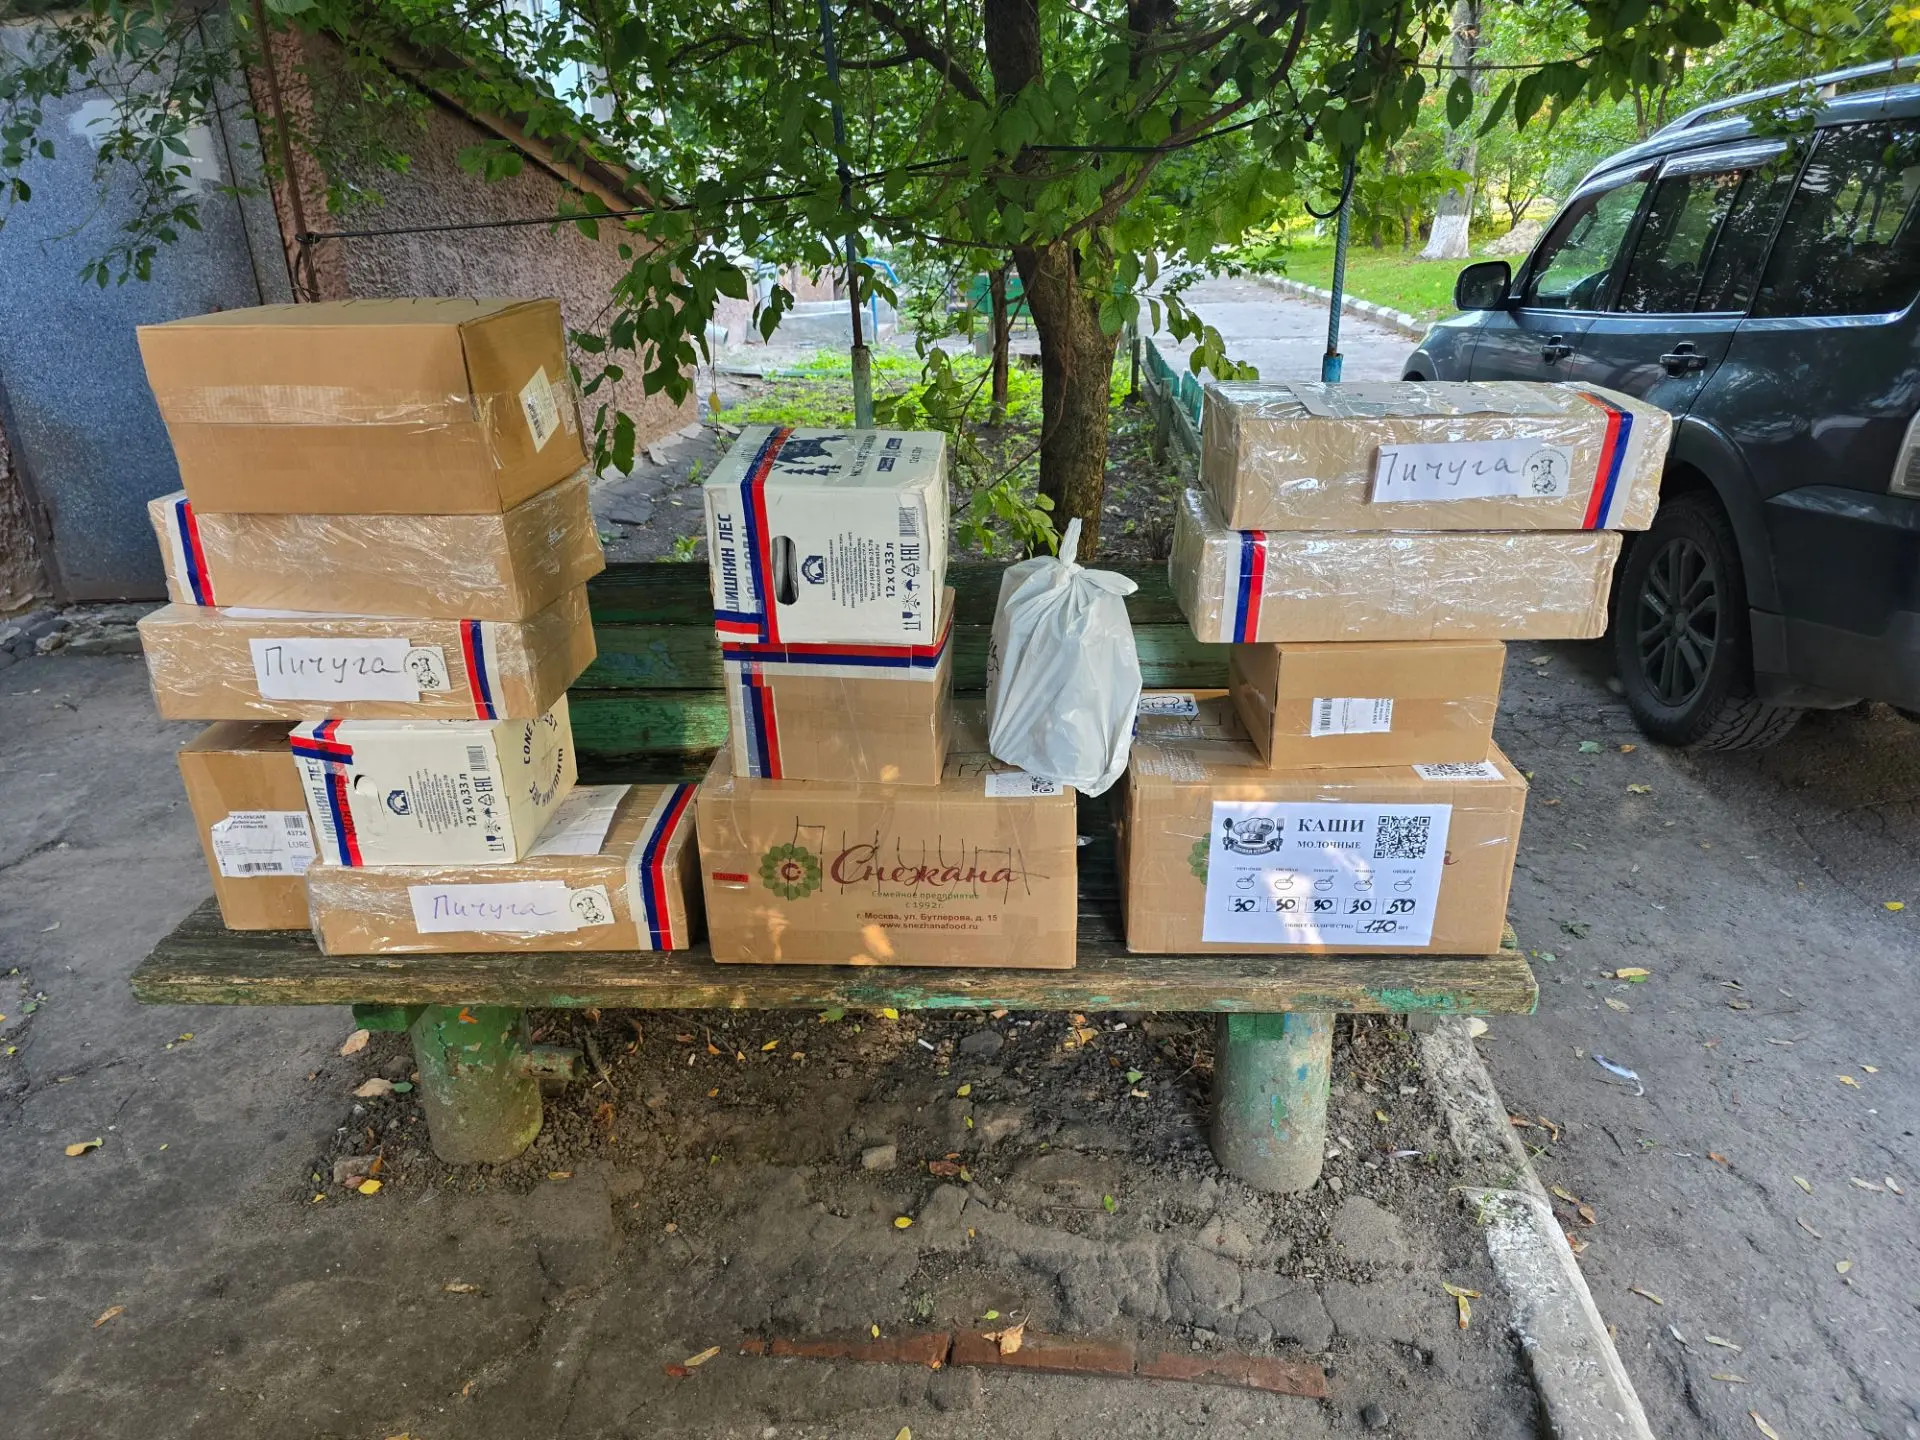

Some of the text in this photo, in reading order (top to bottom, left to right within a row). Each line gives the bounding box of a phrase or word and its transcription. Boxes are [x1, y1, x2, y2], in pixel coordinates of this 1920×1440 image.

[718, 514, 739, 613] ШИШКИН ЛЕС
[885, 551, 896, 574] 0,33
[886, 585, 896, 598] 12
[265, 646, 401, 683] Пичуга
[523, 723, 535, 764] CONE
[460, 783, 473, 805] 0,33
[466, 815, 477, 828] 12
[1298, 818, 1366, 833] КАШИ
[1297, 840, 1362, 850] МОЛОЧНЫЕ
[830, 844, 1020, 888] Снежана
[872, 890, 918, 899] Семейное
[433, 894, 557, 920] Пичуга
[1349, 898, 1372, 914] 30
[1386, 898, 1416, 914] 50
[865, 912, 901, 921] Москва,
[920, 913, 974, 922] Бутлерова,
[987, 914, 998, 922] 15
[879, 922, 979, 930] www.snezhanafood.ru
[1364, 919, 1397, 933] 170
